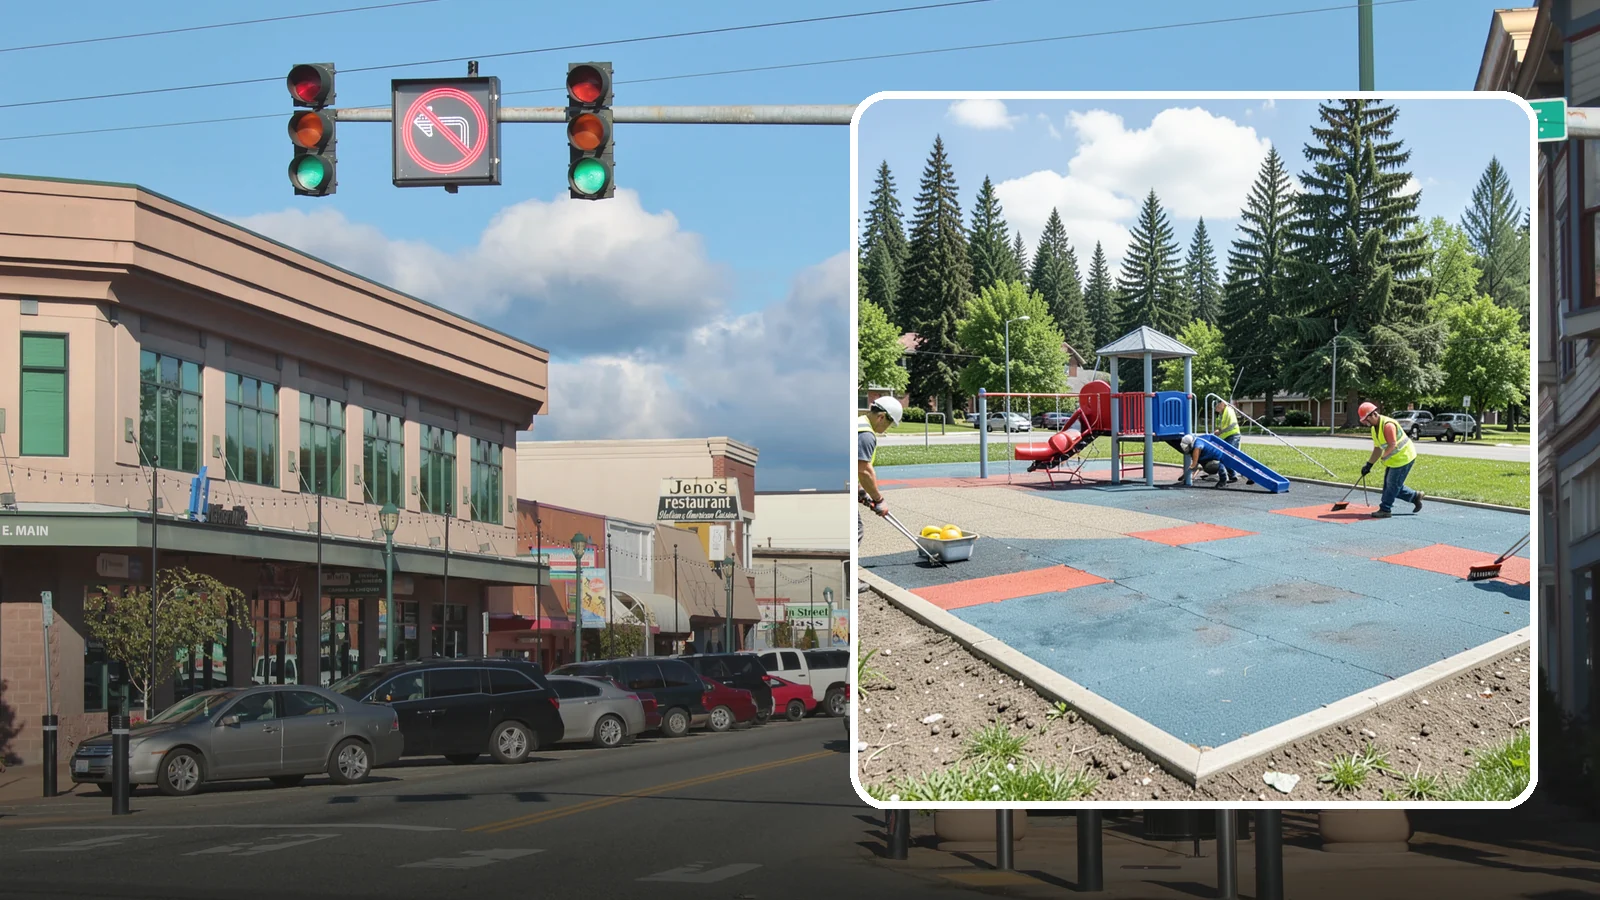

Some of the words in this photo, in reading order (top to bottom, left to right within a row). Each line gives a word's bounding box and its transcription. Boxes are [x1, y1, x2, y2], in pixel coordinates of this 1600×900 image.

[670, 480, 727, 494] Jeno's
[665, 496, 731, 509] restaurant
[686, 510, 714, 519] American
[715, 510, 737, 519] Cuisine
[2, 525, 12, 536] E.
[16, 525, 49, 536] MAIN
[797, 607, 828, 616] Street
